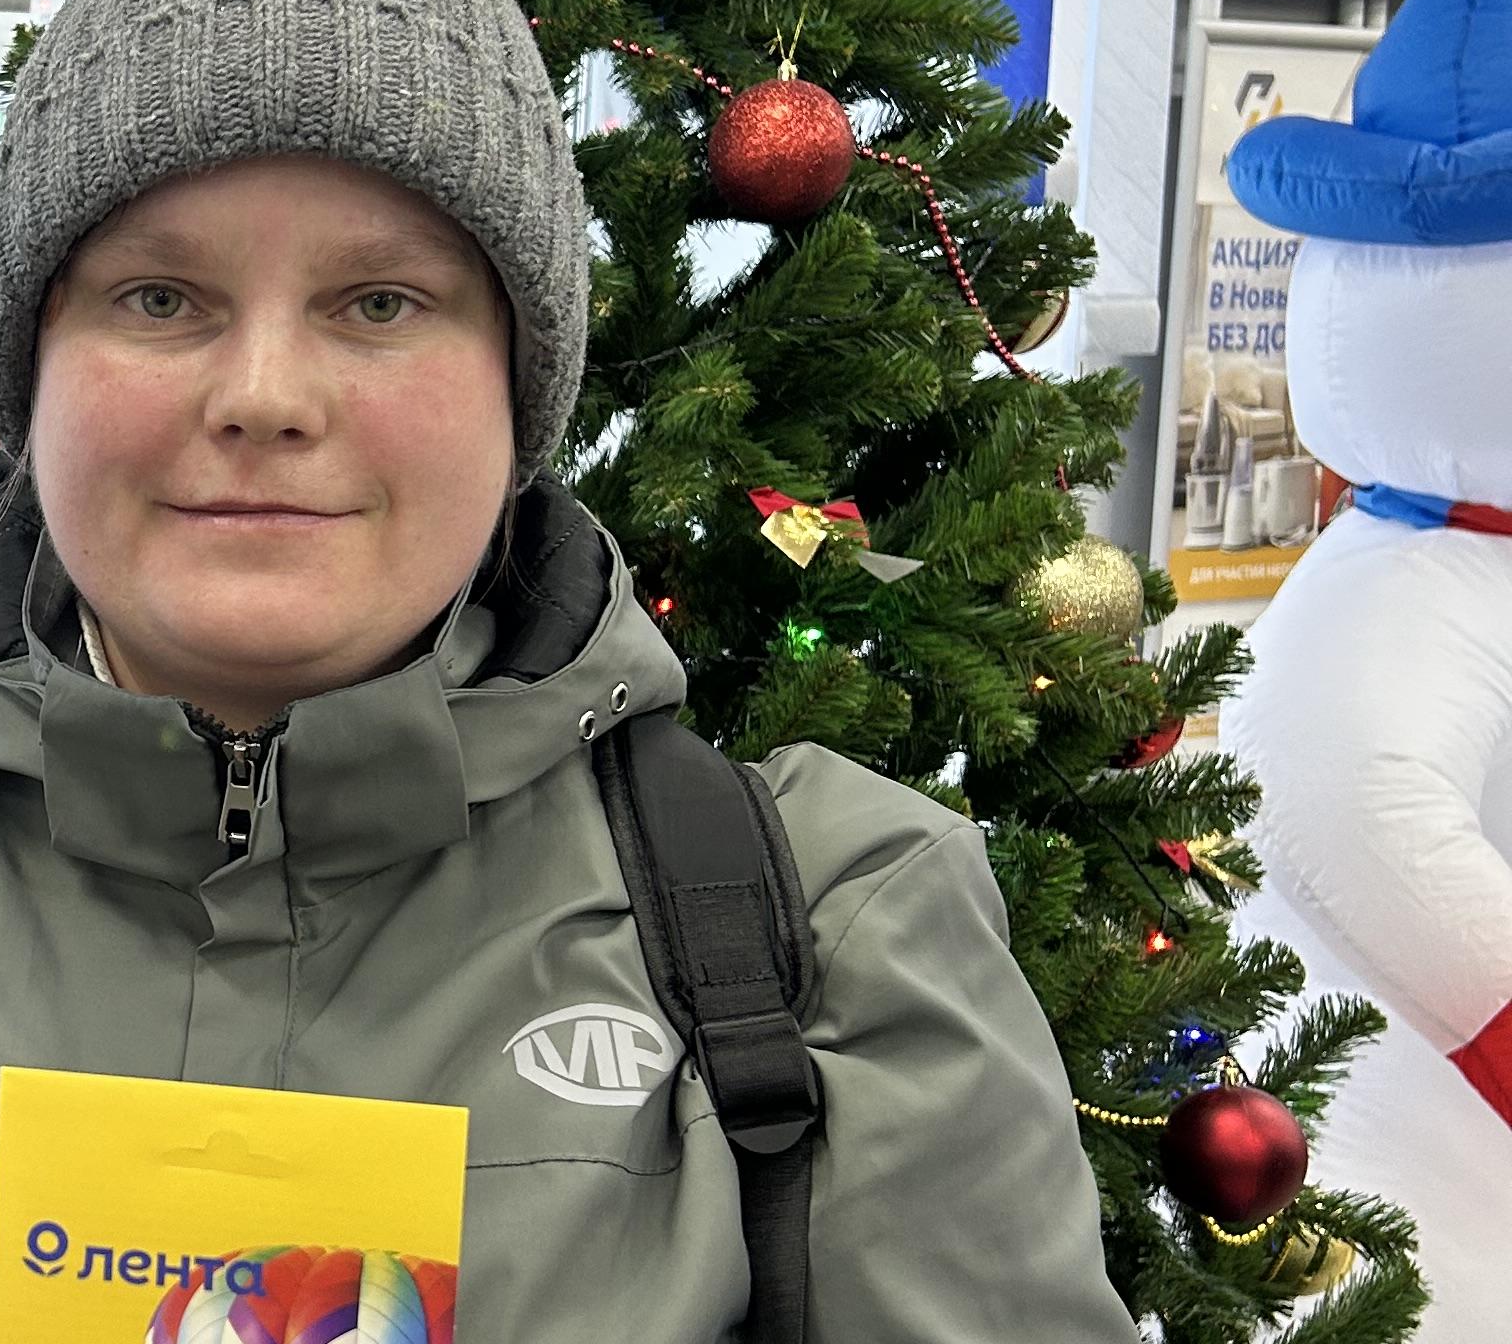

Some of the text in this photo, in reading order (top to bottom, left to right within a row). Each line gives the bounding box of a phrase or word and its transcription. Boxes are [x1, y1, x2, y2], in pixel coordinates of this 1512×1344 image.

[1212, 238, 1301, 272] АКЦИЯ
[1210, 280, 1224, 310] В
[1208, 321, 1248, 352] БЕЗ
[77, 1241, 267, 1298] лента
